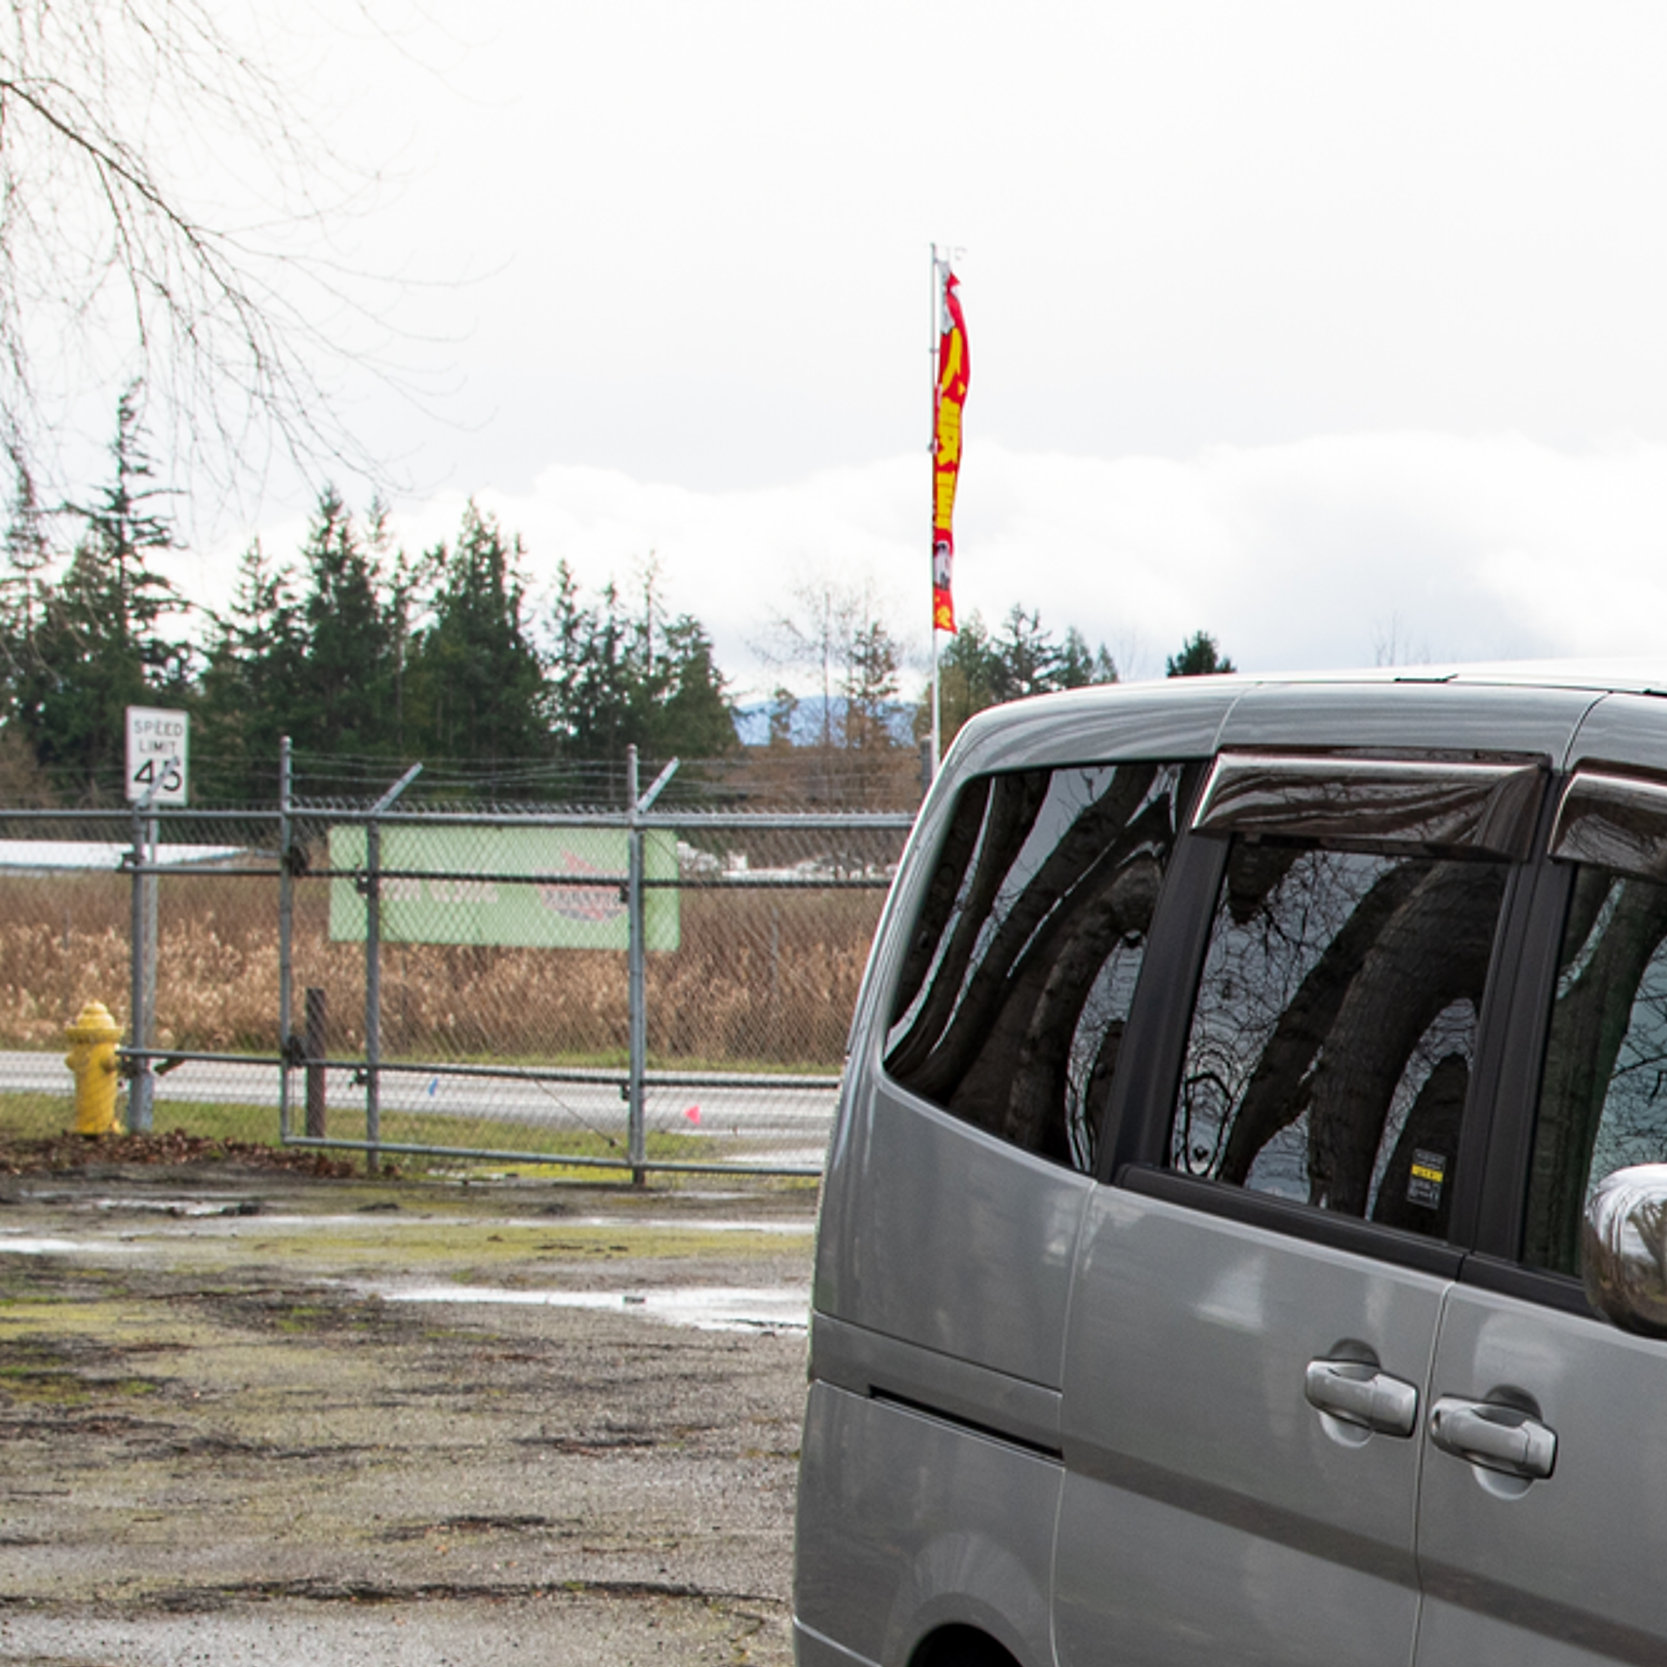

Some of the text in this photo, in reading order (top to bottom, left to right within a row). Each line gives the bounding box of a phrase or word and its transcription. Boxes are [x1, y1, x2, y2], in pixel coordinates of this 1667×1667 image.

[134, 720, 183, 736] SPEED
[139, 740, 176, 754] LIMIT
[134, 759, 182, 792] 45
